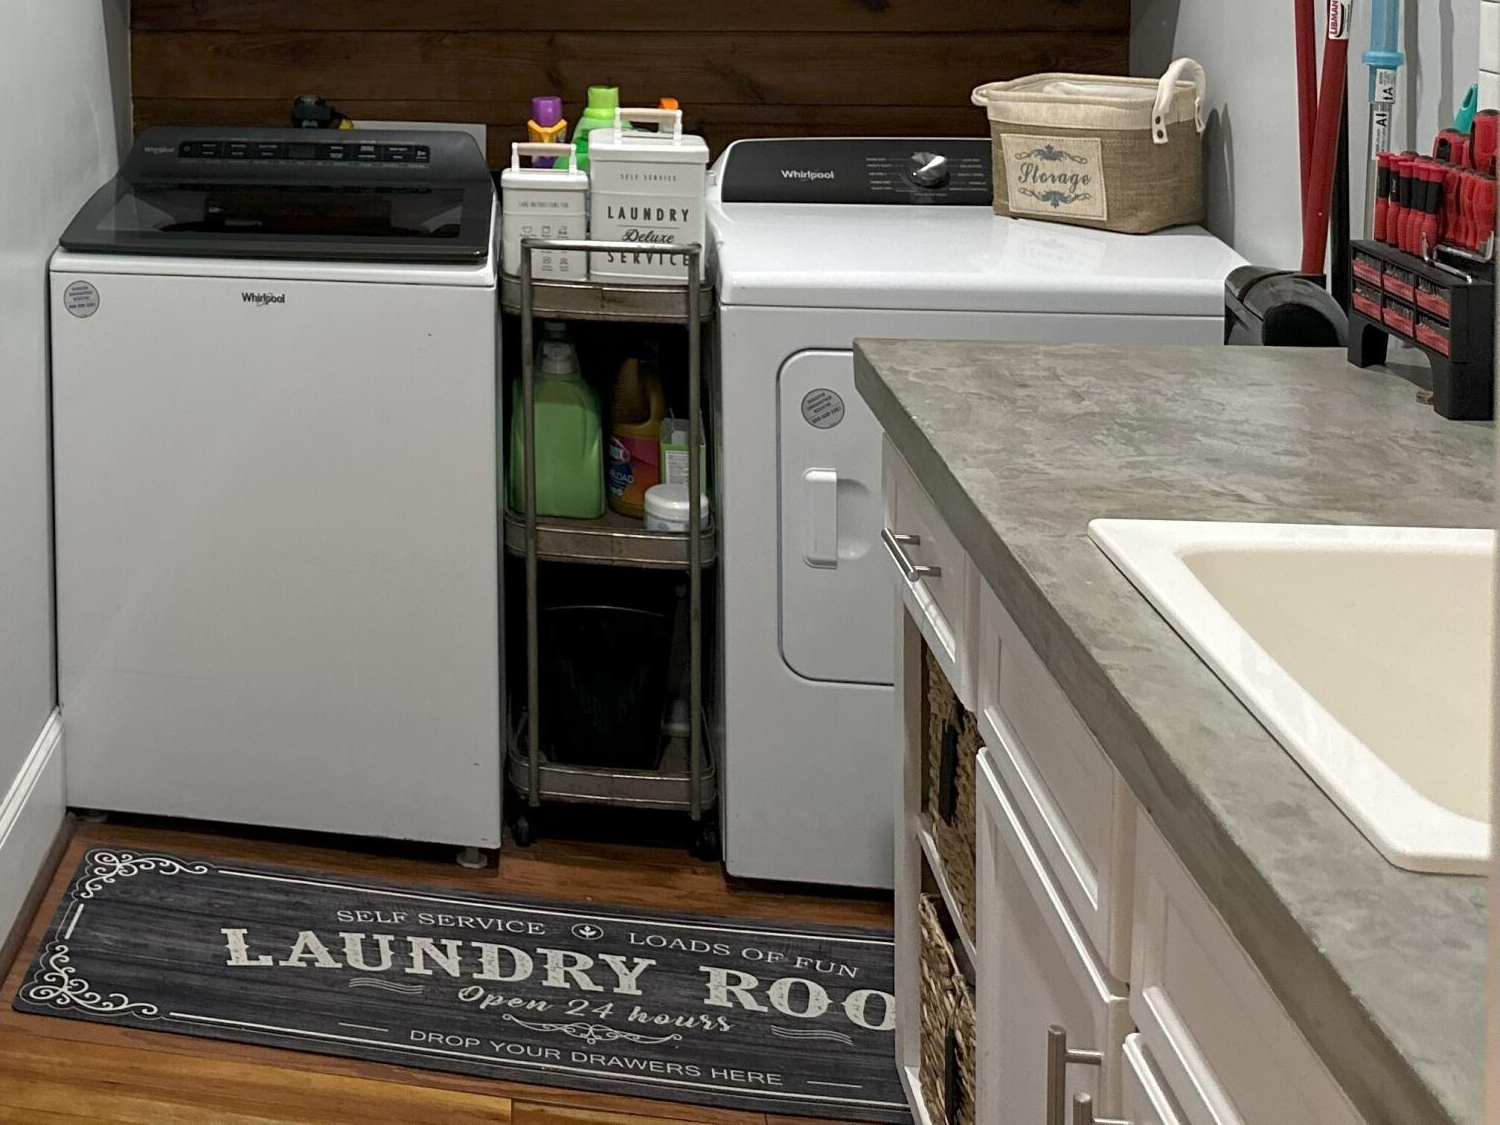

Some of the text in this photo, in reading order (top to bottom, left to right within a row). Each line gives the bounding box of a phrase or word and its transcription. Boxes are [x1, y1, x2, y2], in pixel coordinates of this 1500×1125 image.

[1329, 0, 1339, 35] LIBMAN
[643, 174, 677, 182] SERVICE
[781, 169, 835, 181] Whirlpool
[1018, 162, 1091, 193] Storage
[607, 205, 689, 222] LAUNDRY
[621, 228, 675, 243] Deluxe
[607, 251, 691, 267] SERVICE
[241, 292, 285, 306] Whirlpool
[336, 910, 860, 979] SELF SERVICE LOADS OF FUN
[220, 927, 896, 1031] LAUNDRY ROO
[457, 985, 733, 1033] Open 24 hours
[410, 1029, 785, 1086] DROP YOUR DRAWERS HERE
